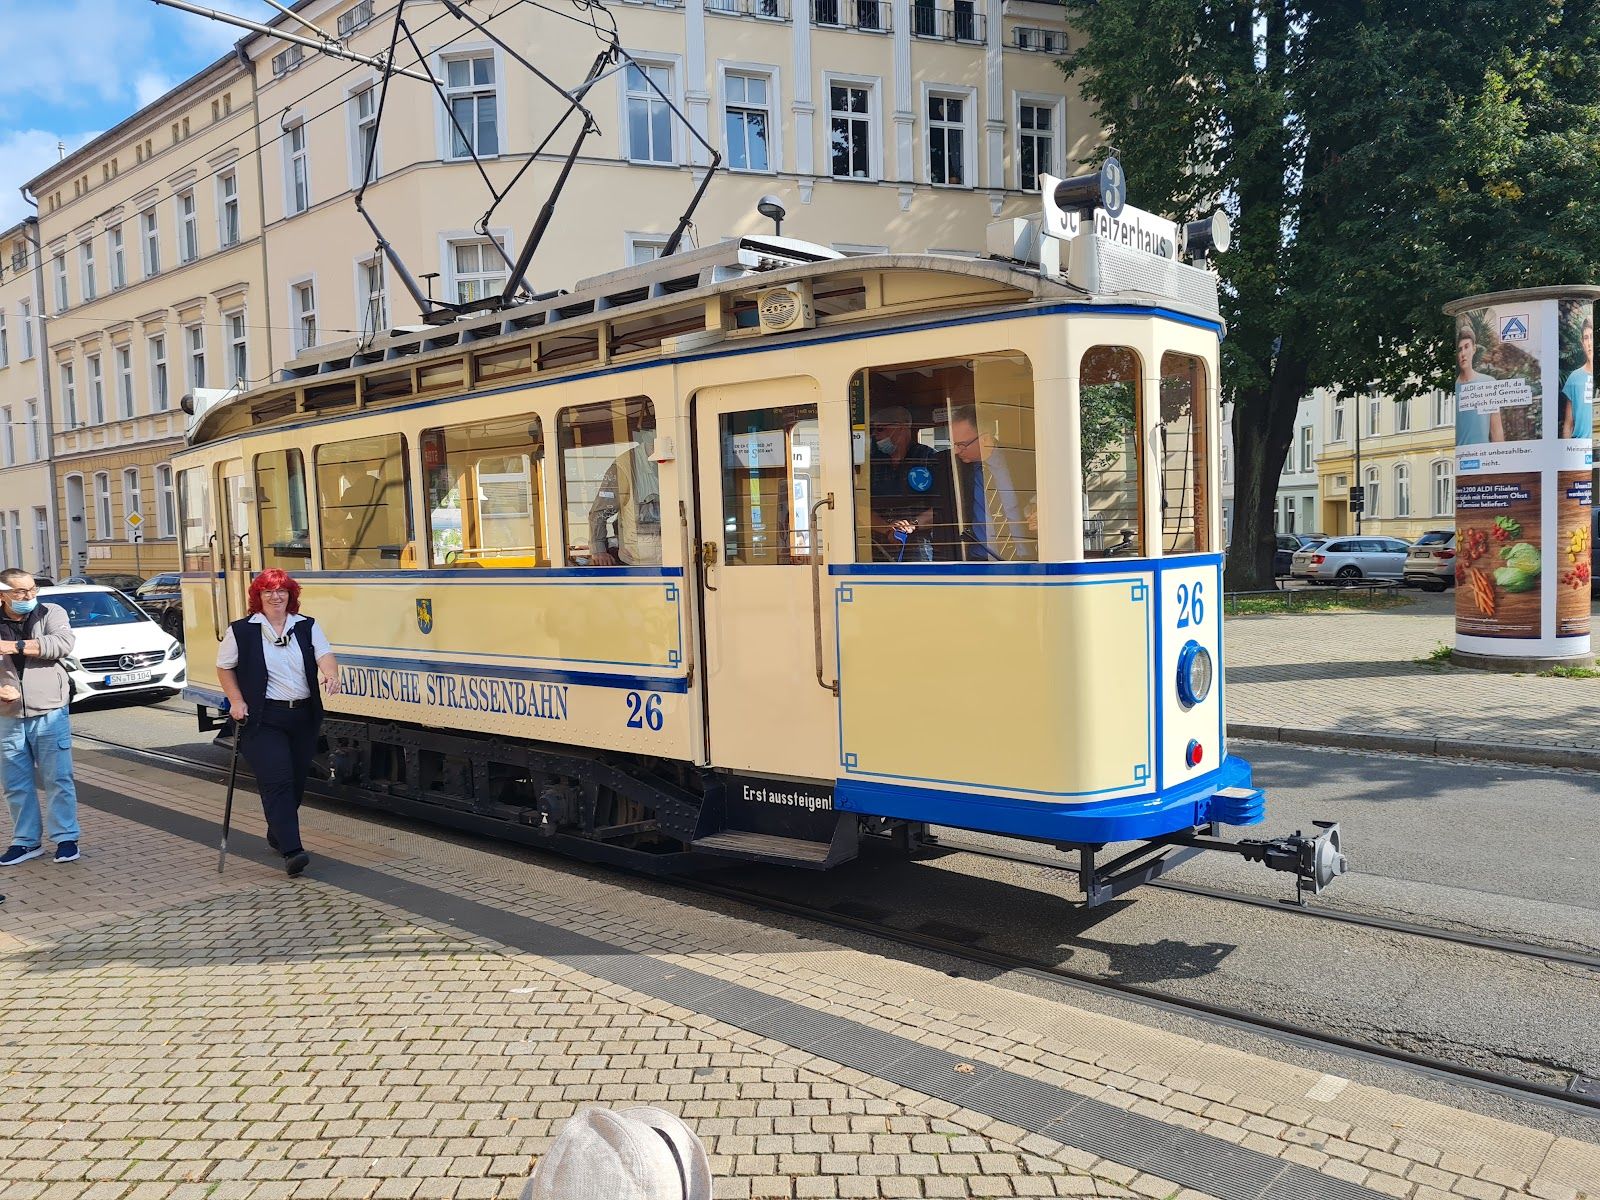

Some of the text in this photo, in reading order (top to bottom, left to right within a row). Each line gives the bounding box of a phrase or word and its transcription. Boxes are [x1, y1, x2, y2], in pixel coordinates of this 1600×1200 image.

[1105, 163, 1121, 211] 3
[1498, 388, 1528, 396] Gemüse
[1488, 447, 1533, 456] unbezahlbar.
[1476, 485, 1493, 493] ALDI
[1494, 484, 1519, 492] Filialen
[1481, 492, 1509, 500] frischem
[1509, 491, 1528, 499] Obst
[1176, 581, 1204, 629] 26
[340, 665, 569, 721] AEDTISCHE STRASSENBAHN
[626, 691, 664, 731] 26
[743, 785, 833, 812] Erst aussteigen!
